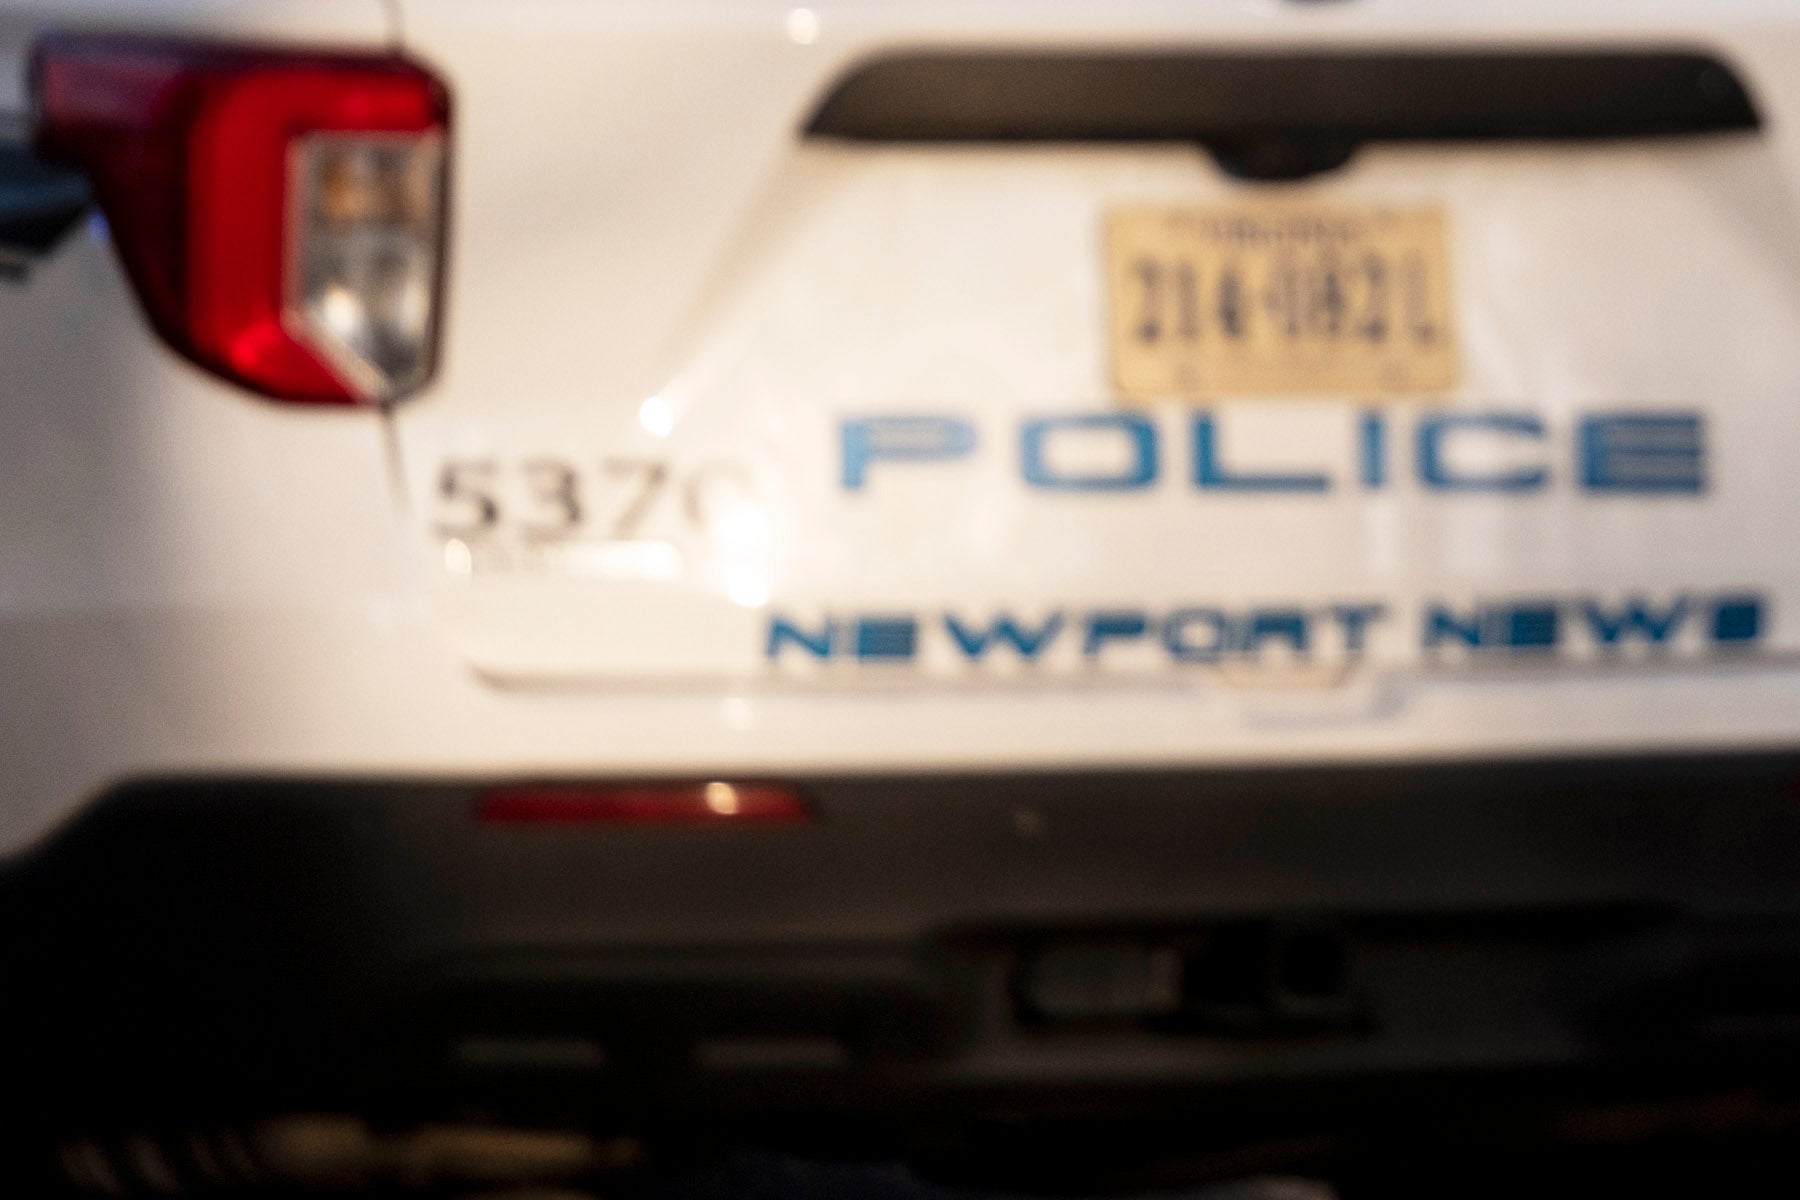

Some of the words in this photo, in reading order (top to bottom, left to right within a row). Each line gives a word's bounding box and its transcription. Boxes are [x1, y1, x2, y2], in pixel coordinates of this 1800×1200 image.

[838, 411, 1708, 494] POLICE
[766, 604, 1384, 662] NEWPORT
[1423, 595, 1770, 649] NEWS
